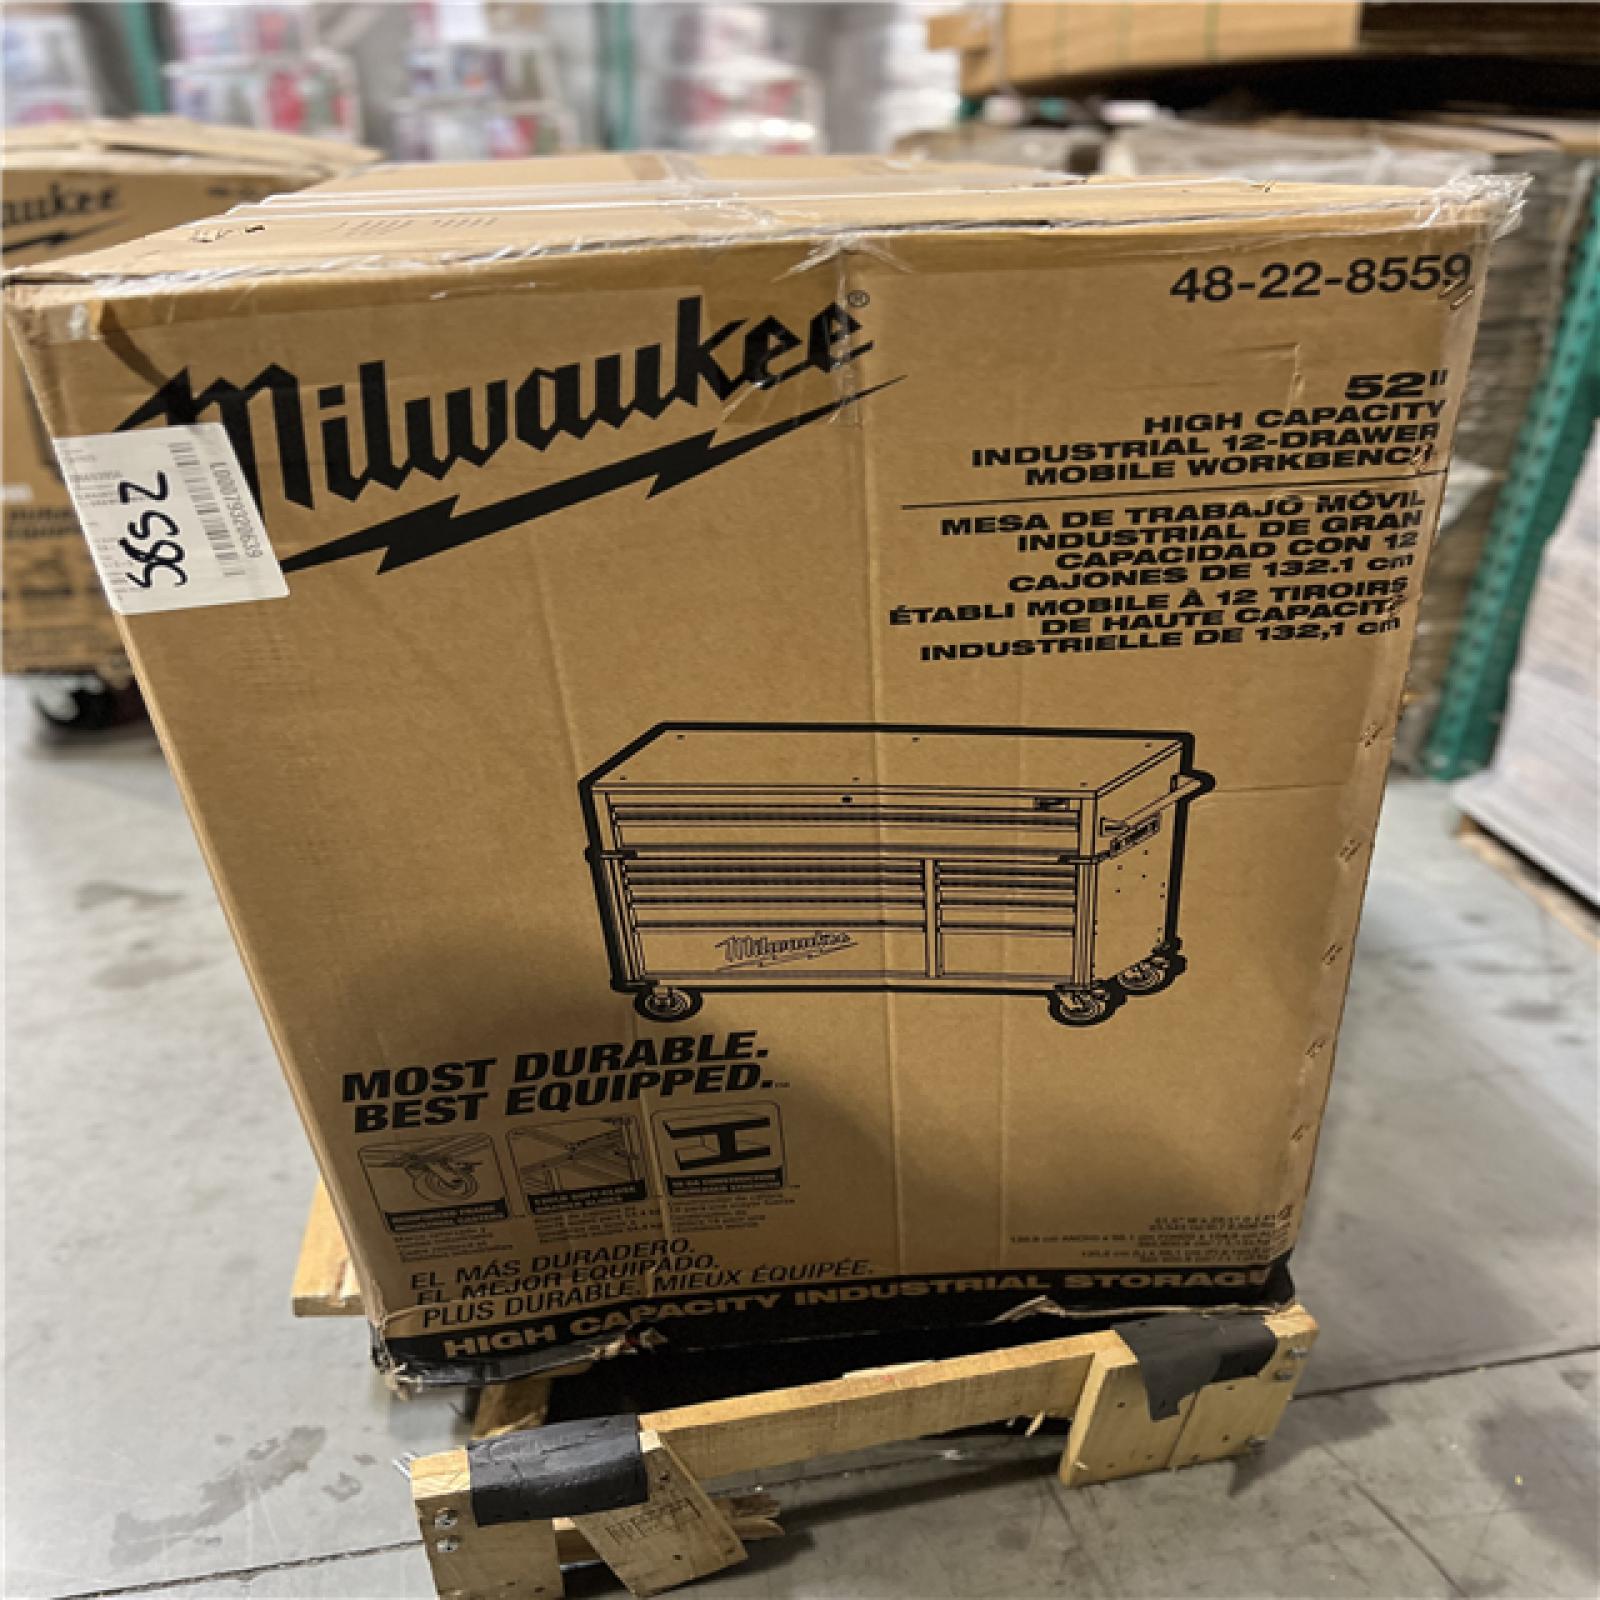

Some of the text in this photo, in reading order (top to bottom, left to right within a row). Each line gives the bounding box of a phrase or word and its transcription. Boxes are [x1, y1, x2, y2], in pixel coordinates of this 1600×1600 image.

[1170, 254, 1471, 302] 48-22-8559
[113, 296, 874, 509] Milwaukee
[1345, 370, 1447, 400] 52"
[1144, 400, 1446, 435] HIGH CAPACITY
[972, 423, 1440, 467] INDUSTRIAL 12-DRAWER
[1025, 460, 1176, 485] MOBILE
[941, 490, 1425, 535] MESA DE TRABAJO MÓVIL
[1018, 510, 1422, 552] INDUSTRIAL DE GRAN
[1008, 554, 1413, 592] CAJONES DE 132.1 cm
[1055, 531, 1418, 570] CAPACIDAD CON 12
[889, 576, 1408, 625] ÉTABLI MOBILE À 12 TIROIRS
[1042, 617, 1091, 635] DE
[1103, 609, 1224, 632] HAUTE
[920, 617, 1401, 661] INDUSTRIELLE DE 132,1 cm
[342, 1030, 769, 1100] MOST DURABLE.
[354, 1063, 774, 1133] BEST EQUIPPED.
[411, 1271, 446, 1290] EL
[456, 1260, 520, 1284] MÁS
[532, 1237, 695, 1273] DURADERO.
[462, 1271, 561, 1300] MEJOR
[571, 1254, 720, 1283] EQUIPADO.
[423, 1258, 873, 1328] PLUS DURABLE. MIEUX ÉQUIPÉE.
[444, 1325, 557, 1358] HIGH
[569, 1295, 781, 1336] CAPACITY
[795, 1274, 1050, 1306] INDUSTRIAL
